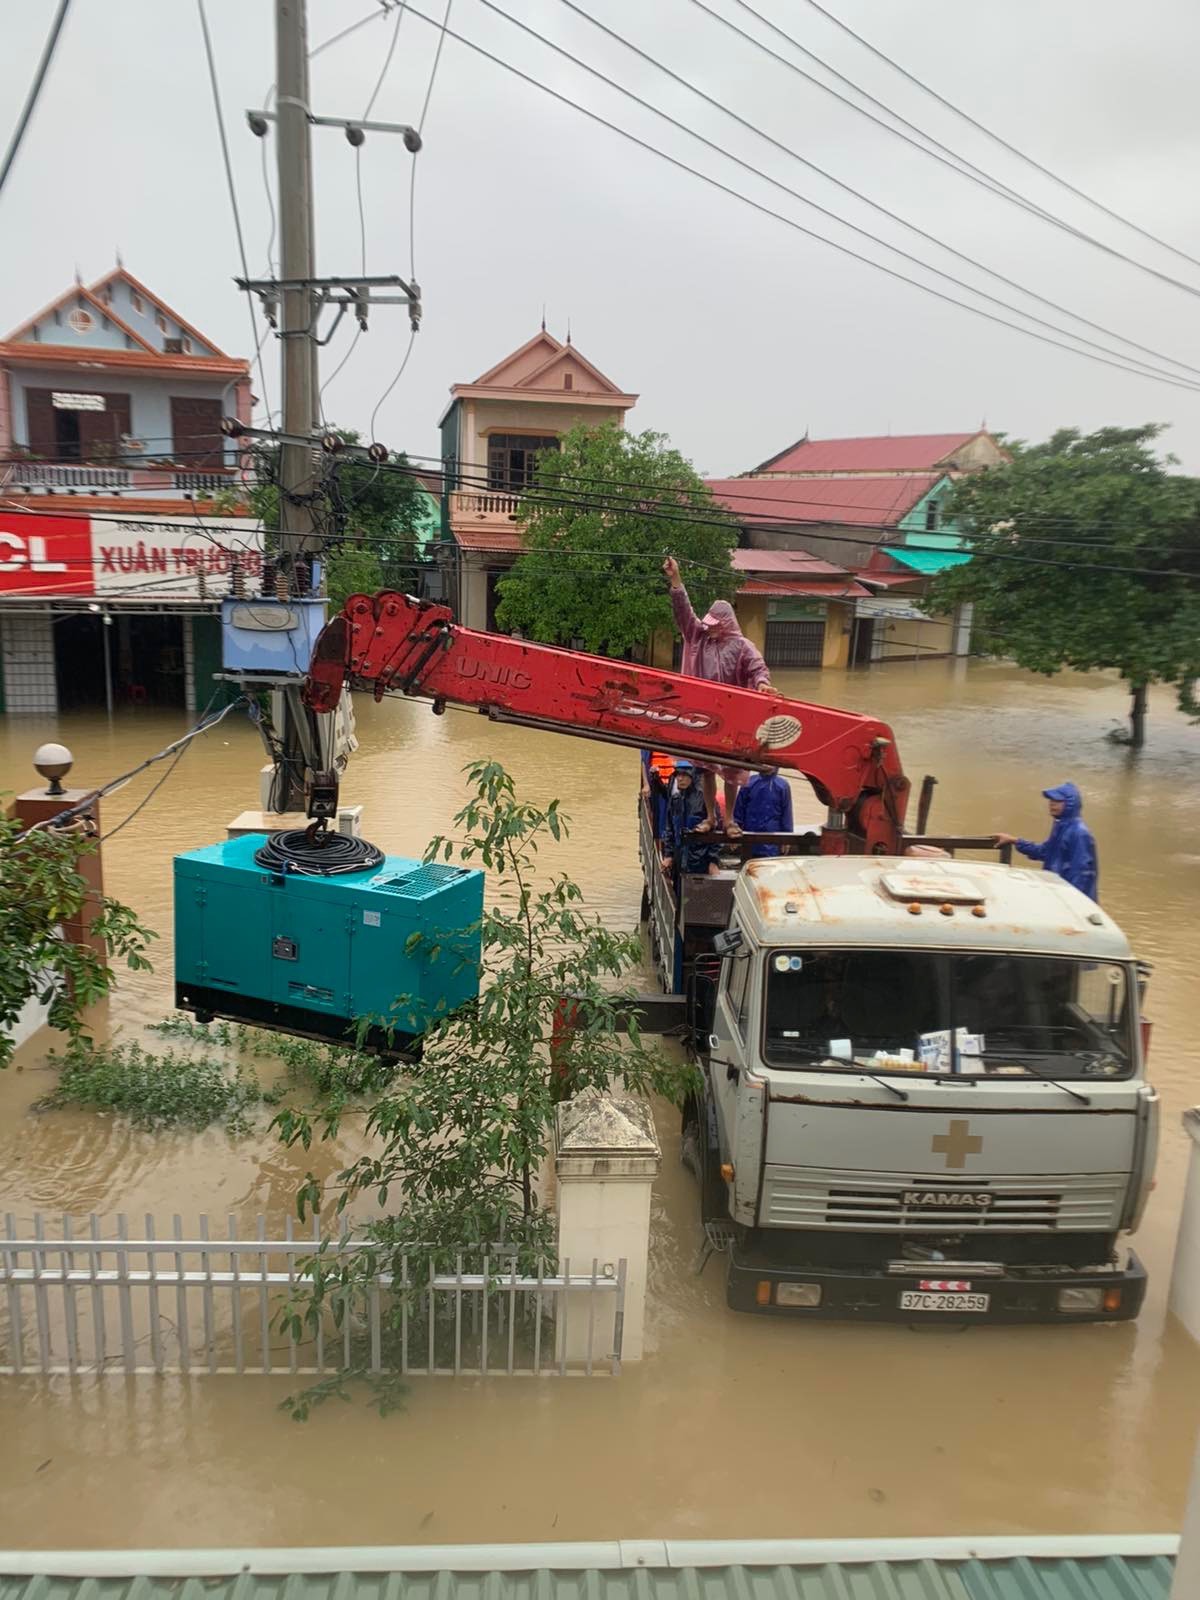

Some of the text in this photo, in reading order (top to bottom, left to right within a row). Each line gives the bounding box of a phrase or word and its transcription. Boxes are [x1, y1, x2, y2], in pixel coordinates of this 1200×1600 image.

[99, 540, 262, 577] XUÂN TRƯỜG
[456, 655, 531, 690] UNIC
